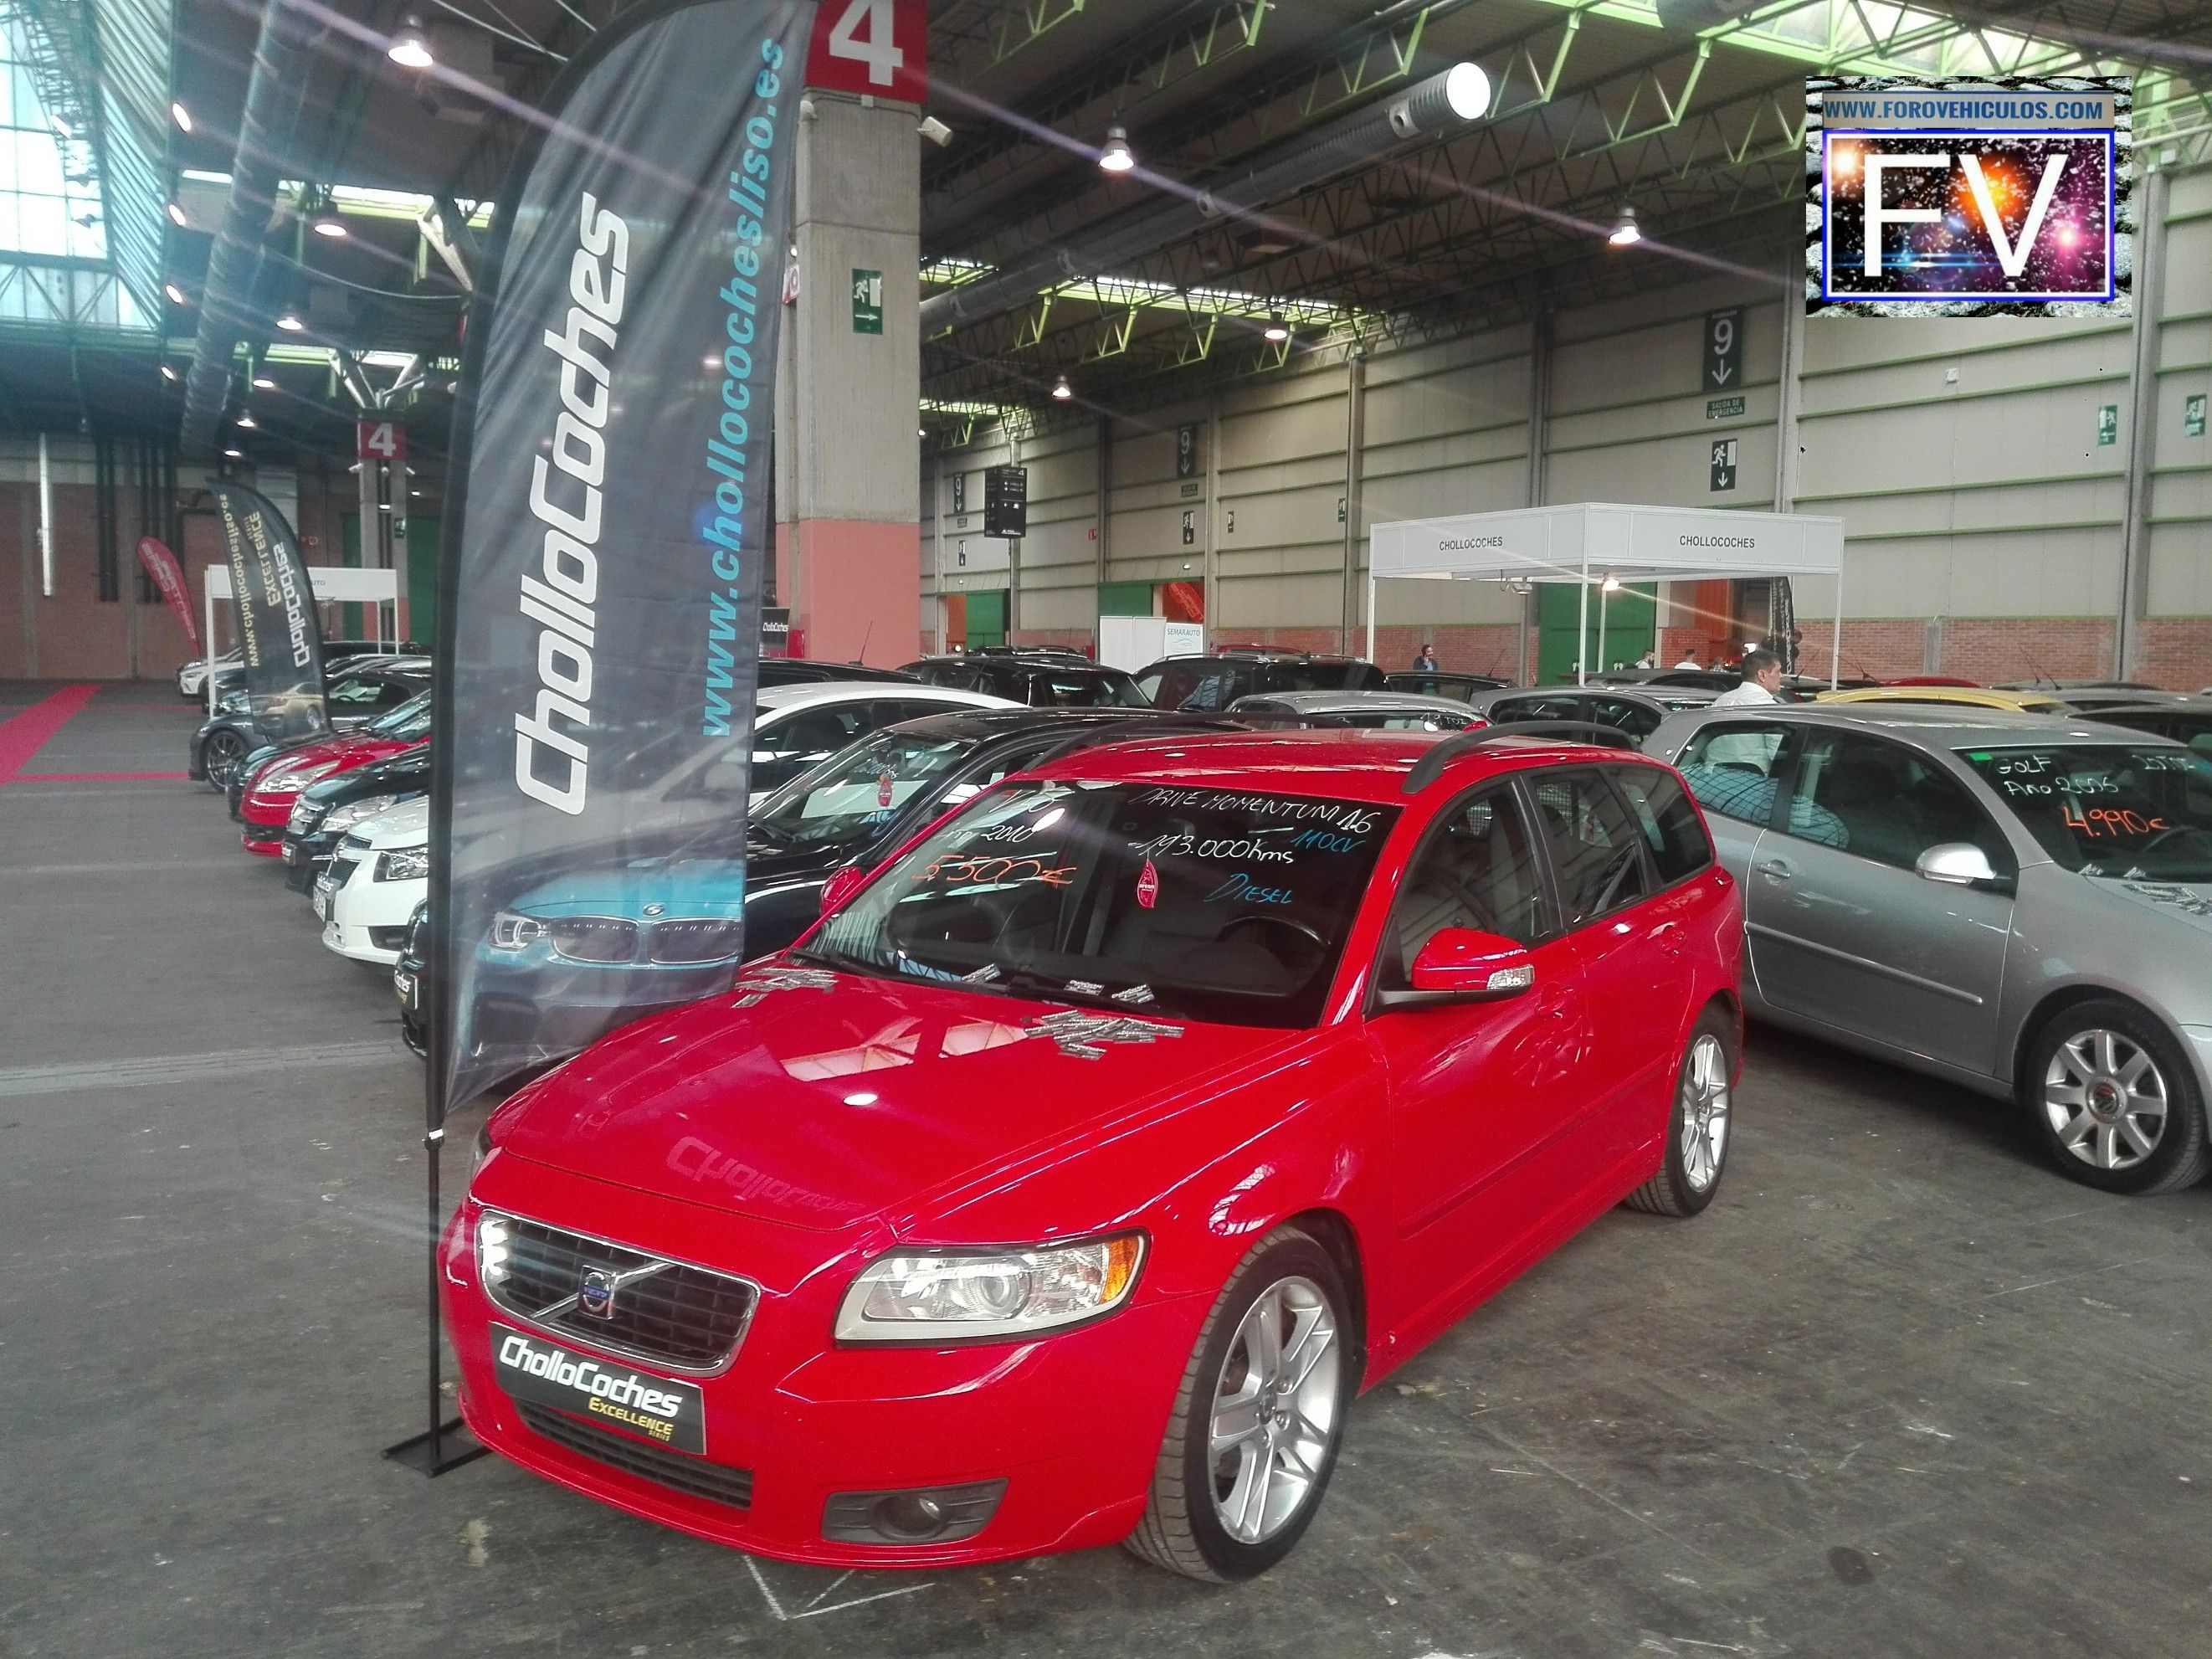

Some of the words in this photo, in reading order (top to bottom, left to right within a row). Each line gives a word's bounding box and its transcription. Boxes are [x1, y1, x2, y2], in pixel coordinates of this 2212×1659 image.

[829, 0, 903, 86] 4
[1714, 319, 1733, 355] 9
[703, 39, 784, 737] www.chollocochesliso.es
[368, 422, 396, 457] 4
[1181, 431, 1190, 455] 9
[515, 193, 629, 815] CholloCoches
[956, 478, 962, 496] 9
[1439, 536, 1503, 552] CHOLLOCOCHES
[1679, 535, 1755, 549] CHOLLOCOCHES
[1167, 628, 1201, 636] SEMARAUTO
[1202, 794, 1340, 821] MOMENTUM
[499, 1335, 683, 1418] CholloCoches
[588, 1396, 675, 1436] EXCELLENCE
